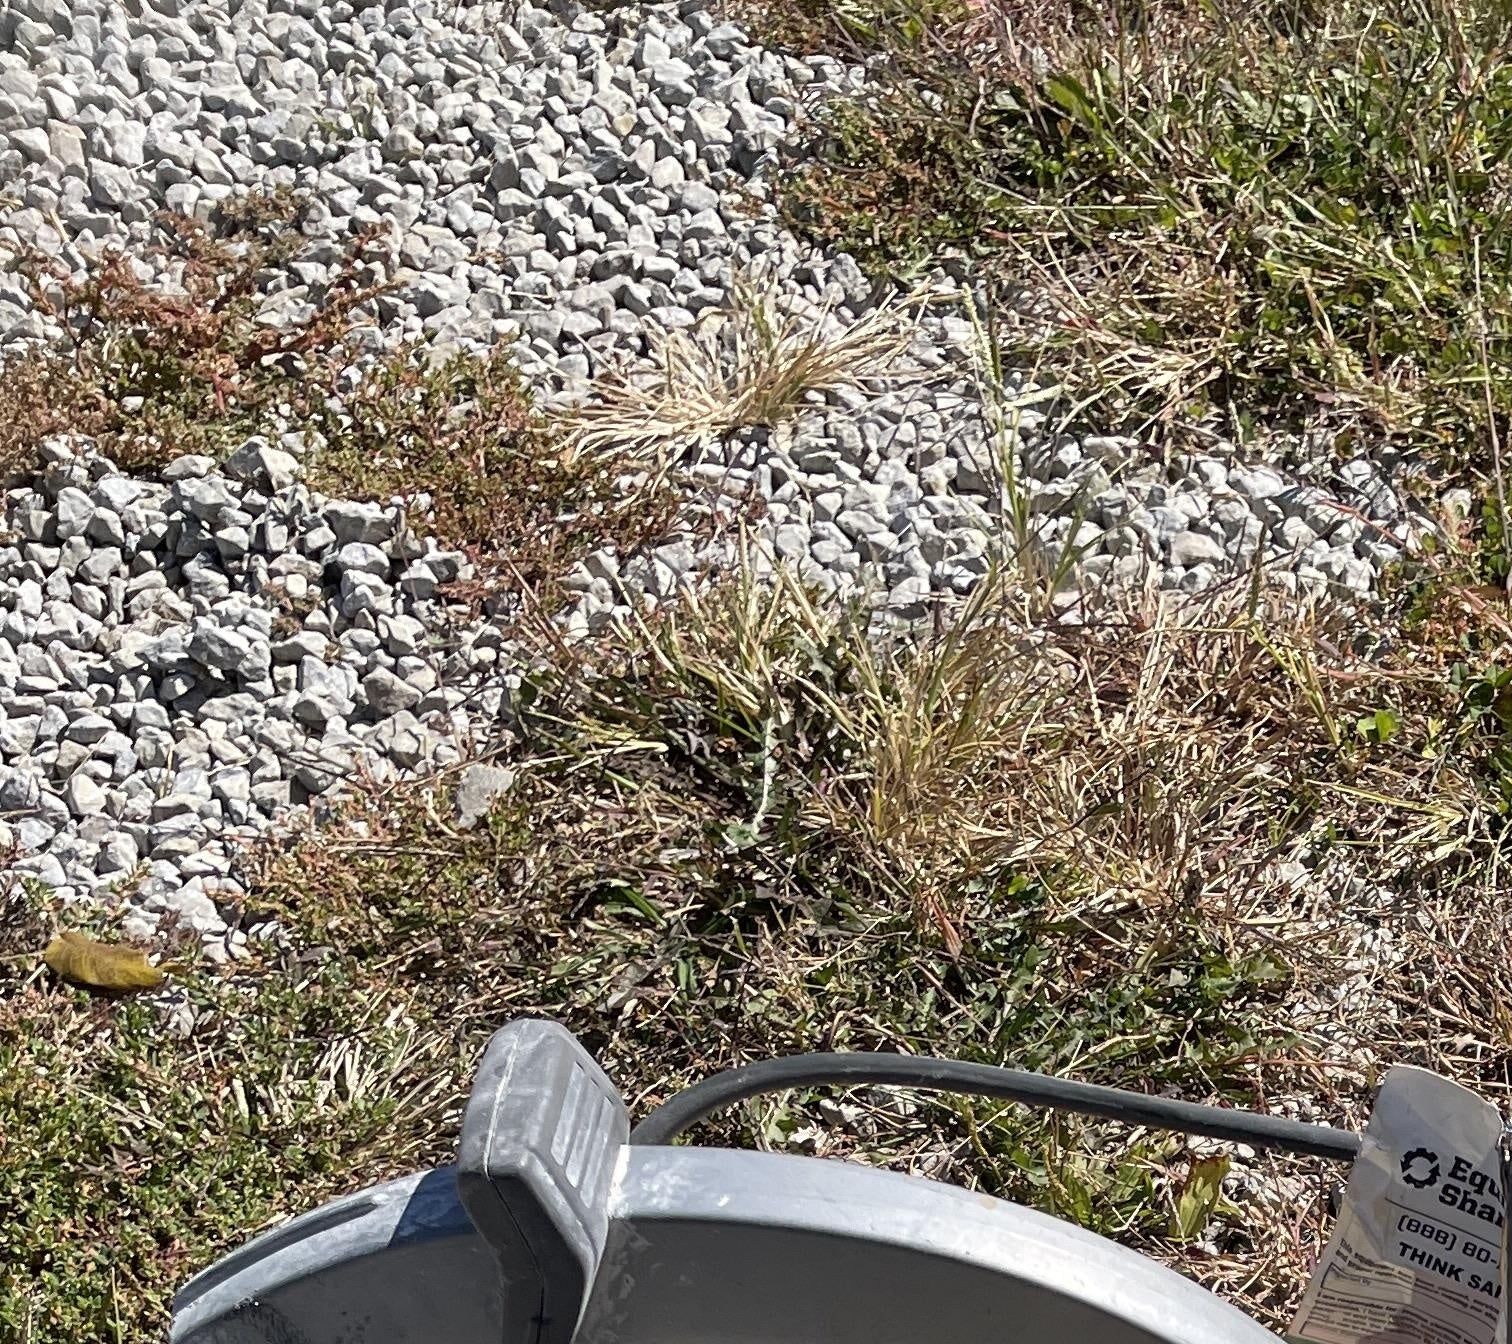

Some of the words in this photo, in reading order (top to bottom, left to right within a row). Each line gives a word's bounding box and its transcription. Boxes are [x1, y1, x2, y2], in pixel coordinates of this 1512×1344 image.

[1447, 1155, 1504, 1207] Equ
[1396, 1213, 1458, 1252] (888)
[1462, 1241, 1501, 1269] 80-
[1399, 1241, 1465, 1282] THINK
